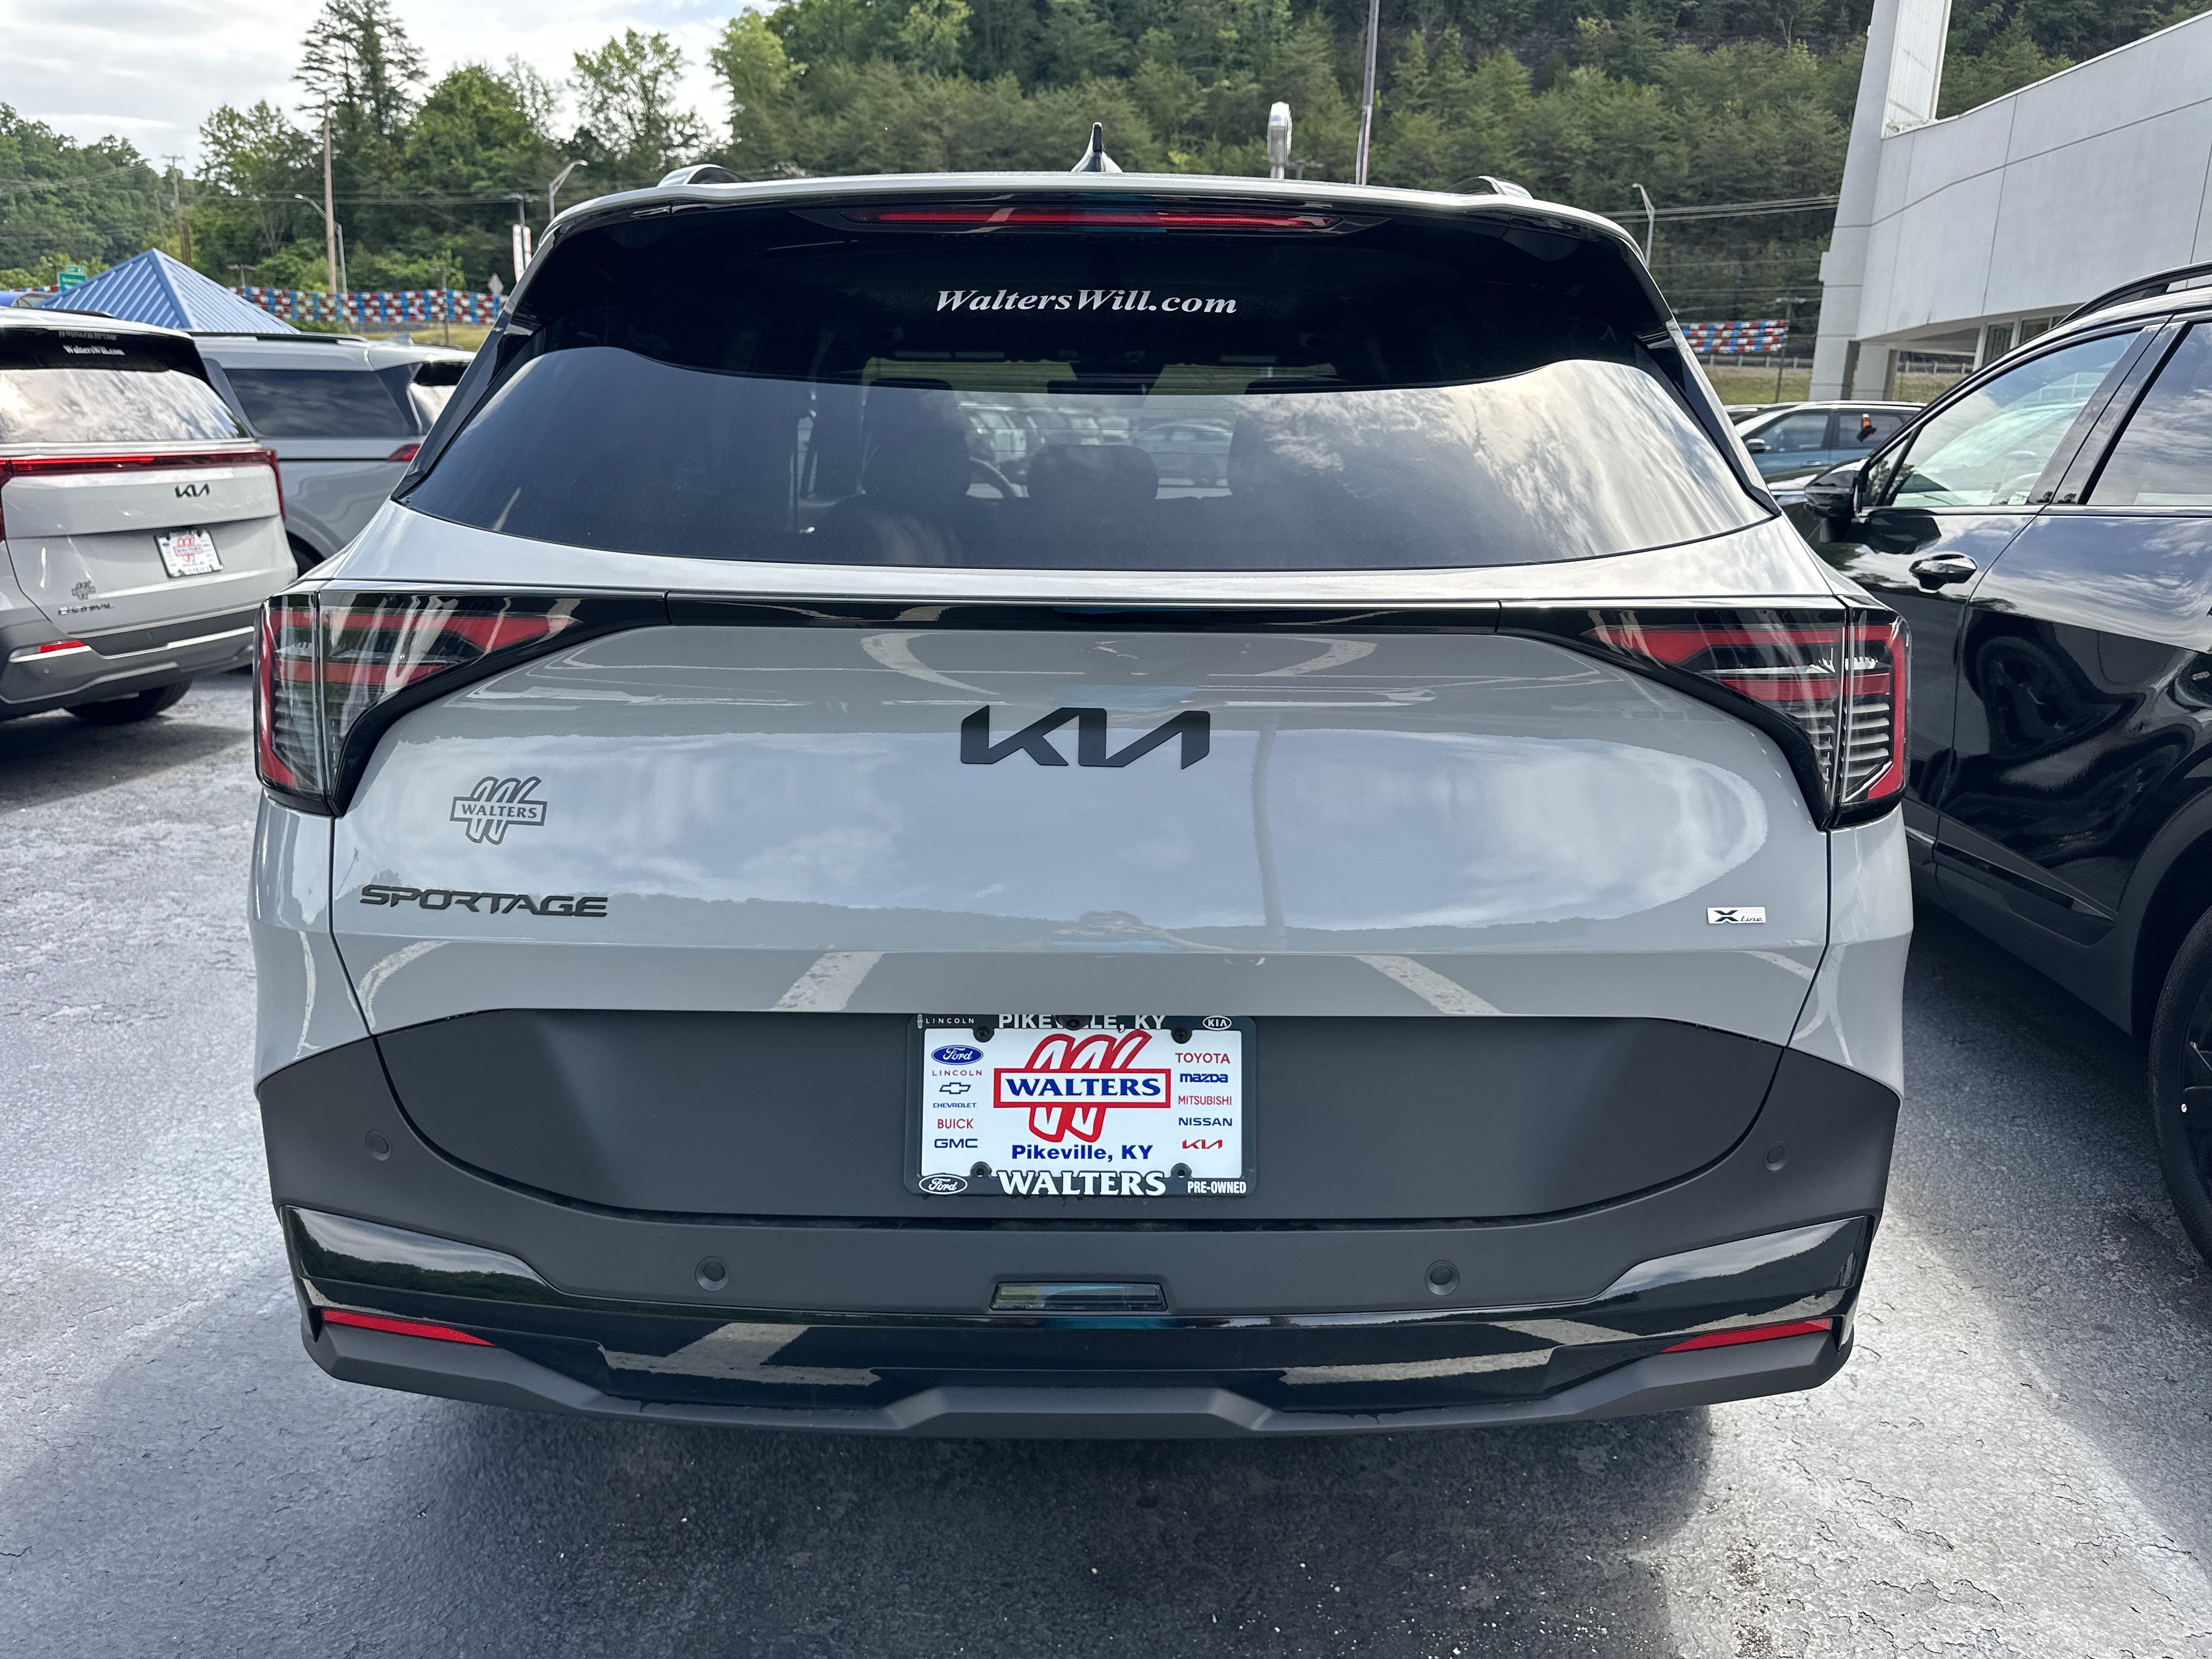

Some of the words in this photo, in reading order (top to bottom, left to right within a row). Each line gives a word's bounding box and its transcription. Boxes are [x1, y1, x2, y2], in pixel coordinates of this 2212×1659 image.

[936, 289, 1237, 313] WaltersWill.com
[174, 482, 211, 499] KIA
[961, 705, 1210, 769] KIA
[461, 804, 537, 819] WALTERS
[360, 884, 608, 917] SPORTAGE
[999, 1014, 1125, 1033] PIKELE,
[1135, 1014, 1166, 1029] KY
[1207, 1018, 1227, 1027] KIA
[942, 1047, 973, 1060] Ford
[1175, 1053, 1231, 1064] TOYOTA
[1180, 1073, 1228, 1083] mazda
[1005, 1078, 1161, 1096] WALTERS
[1178, 1096, 1232, 1105] MITSUBISHI
[937, 1119, 974, 1129] BUICK
[1178, 1117, 1233, 1126] NISSAN
[934, 1138, 978, 1148] GMC
[1182, 1139, 1223, 1149] KIA
[1012, 1144, 1113, 1162] Pikeville,
[1121, 1144, 1154, 1159] KY
[928, 1178, 958, 1191] Ford
[996, 1171, 1166, 1196] WALTERS
[1187, 1181, 1246, 1194] PRE-OWNED
